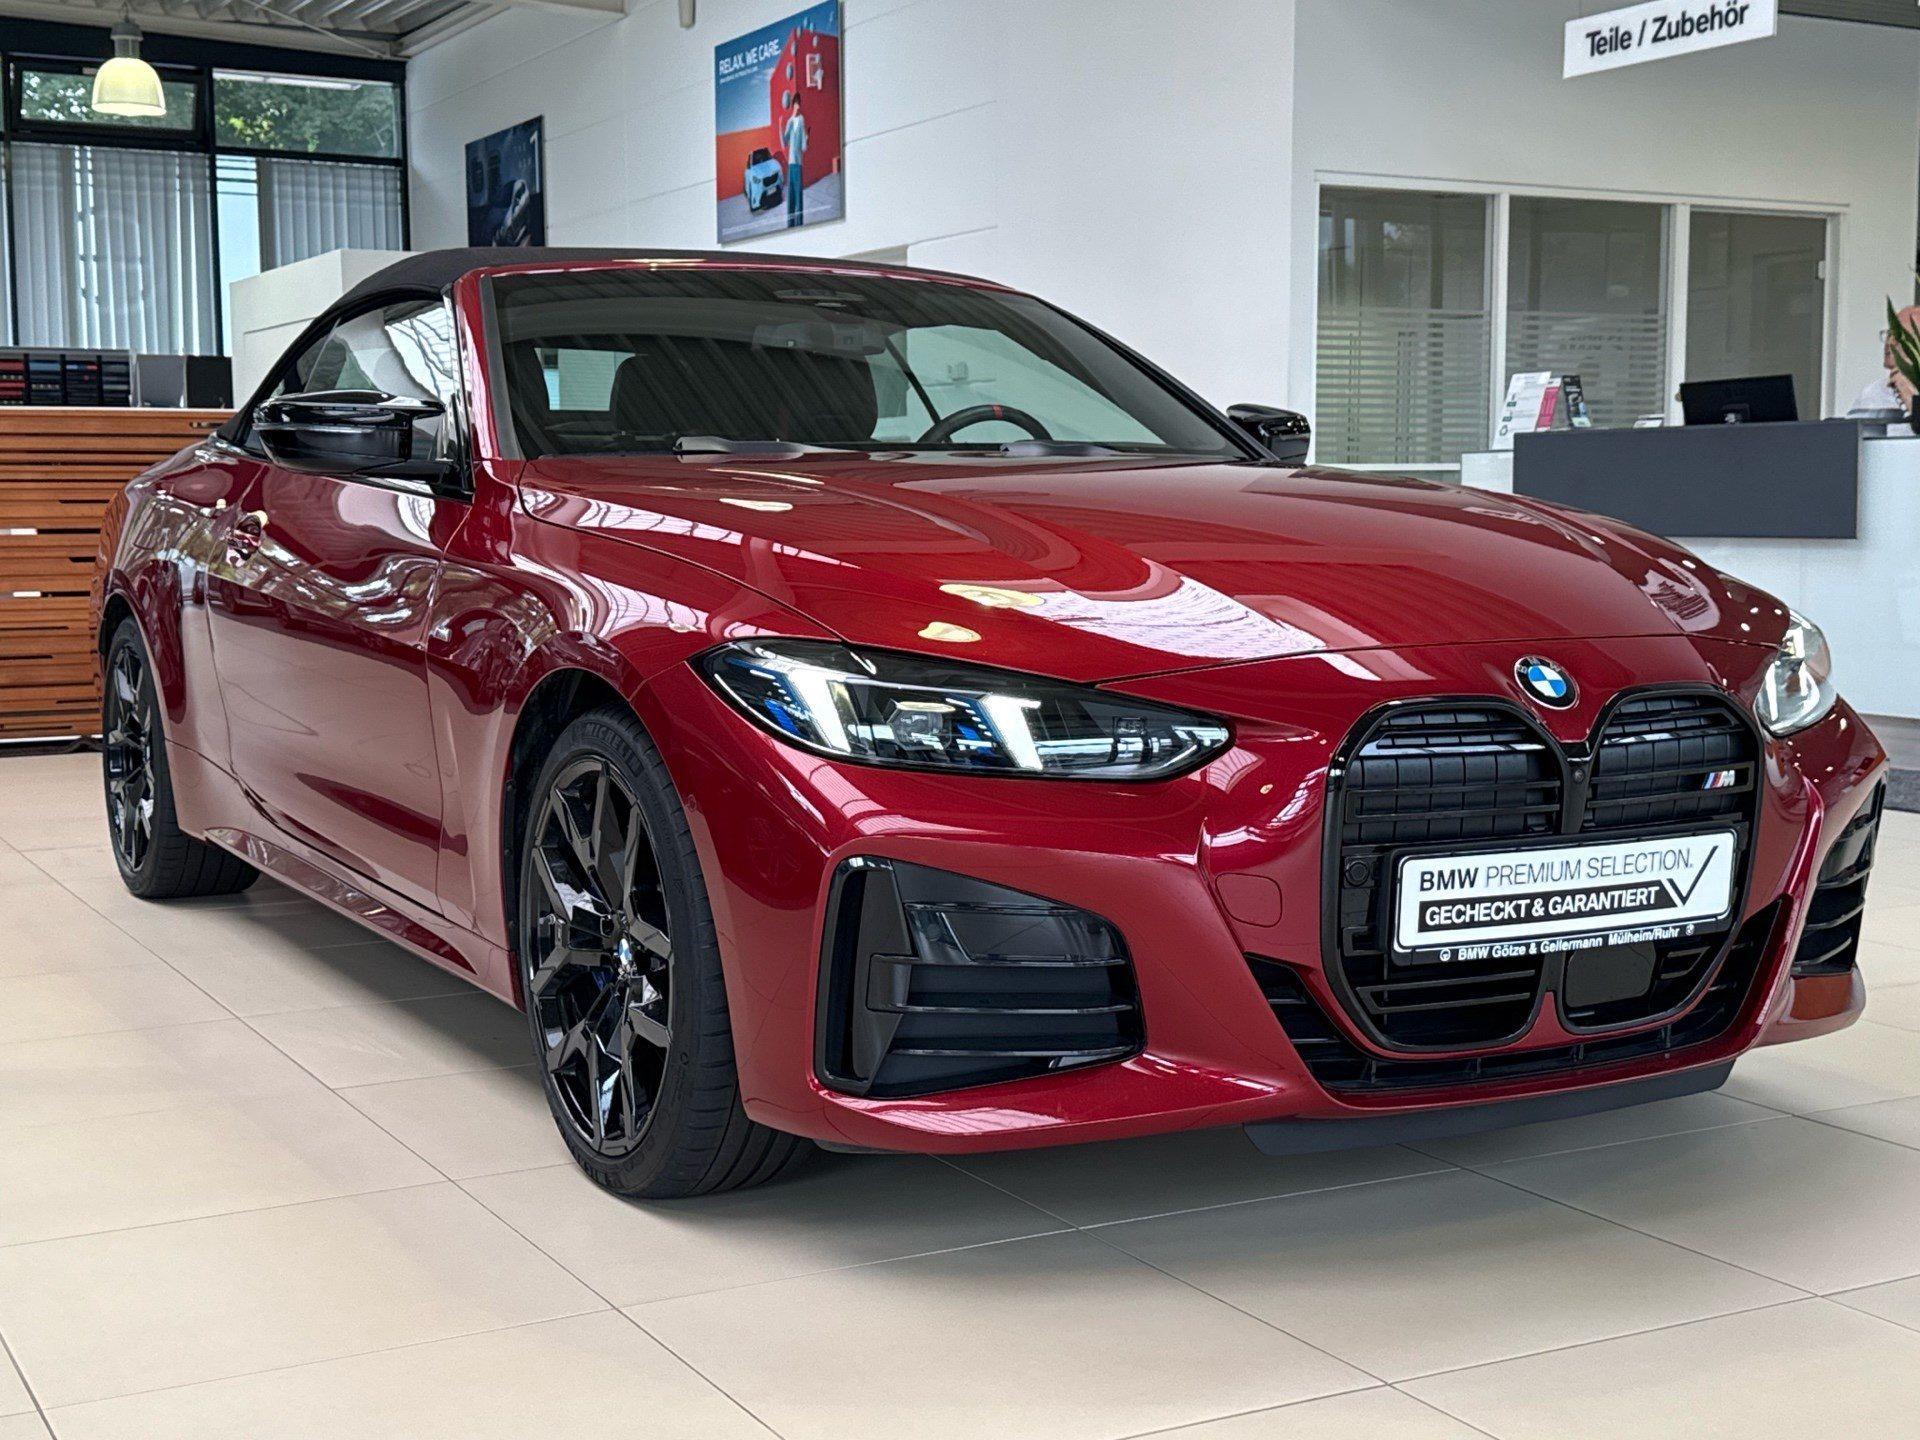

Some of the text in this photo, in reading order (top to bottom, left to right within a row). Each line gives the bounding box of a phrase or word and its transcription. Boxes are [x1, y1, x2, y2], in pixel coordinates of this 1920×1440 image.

[1586, 0, 1750, 57] Teile / Zubehör
[1517, 655, 1562, 675] BMW
[1419, 867, 1480, 892] BMW
[1485, 858, 1582, 888] PREMIUM
[1425, 886, 1660, 927] GECHECKT & GARANTIERT
[1458, 946, 1490, 961] BMW
[1492, 943, 1527, 958] Götze
[1528, 943, 1537, 955] &
[1608, 926, 1681, 946] Mülheim/Ruhr
